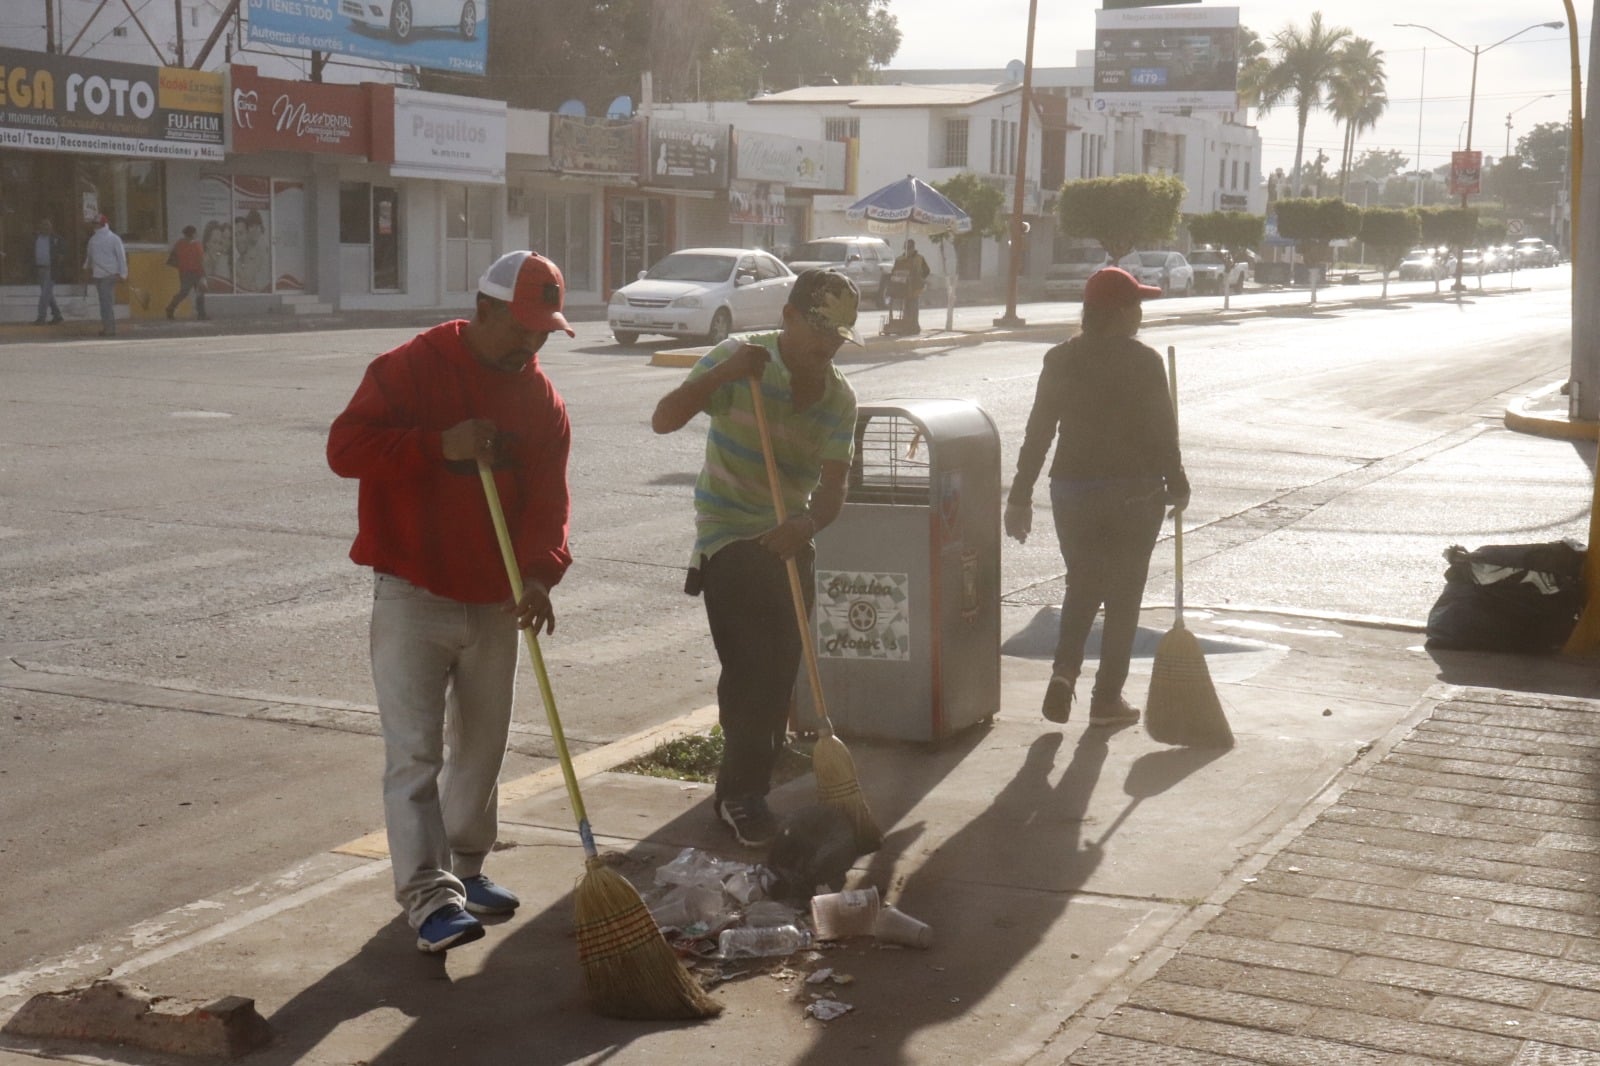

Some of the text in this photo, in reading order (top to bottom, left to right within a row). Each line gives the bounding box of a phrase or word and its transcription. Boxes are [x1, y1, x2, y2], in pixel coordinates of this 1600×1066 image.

[304, 4, 333, 22] TODO
[251, 24, 296, 44] Automar
[298, 33, 311, 45] de
[66, 73, 155, 120] FOTO
[325, 113, 353, 129] DENTAL
[877, 208, 909, 217] debate
